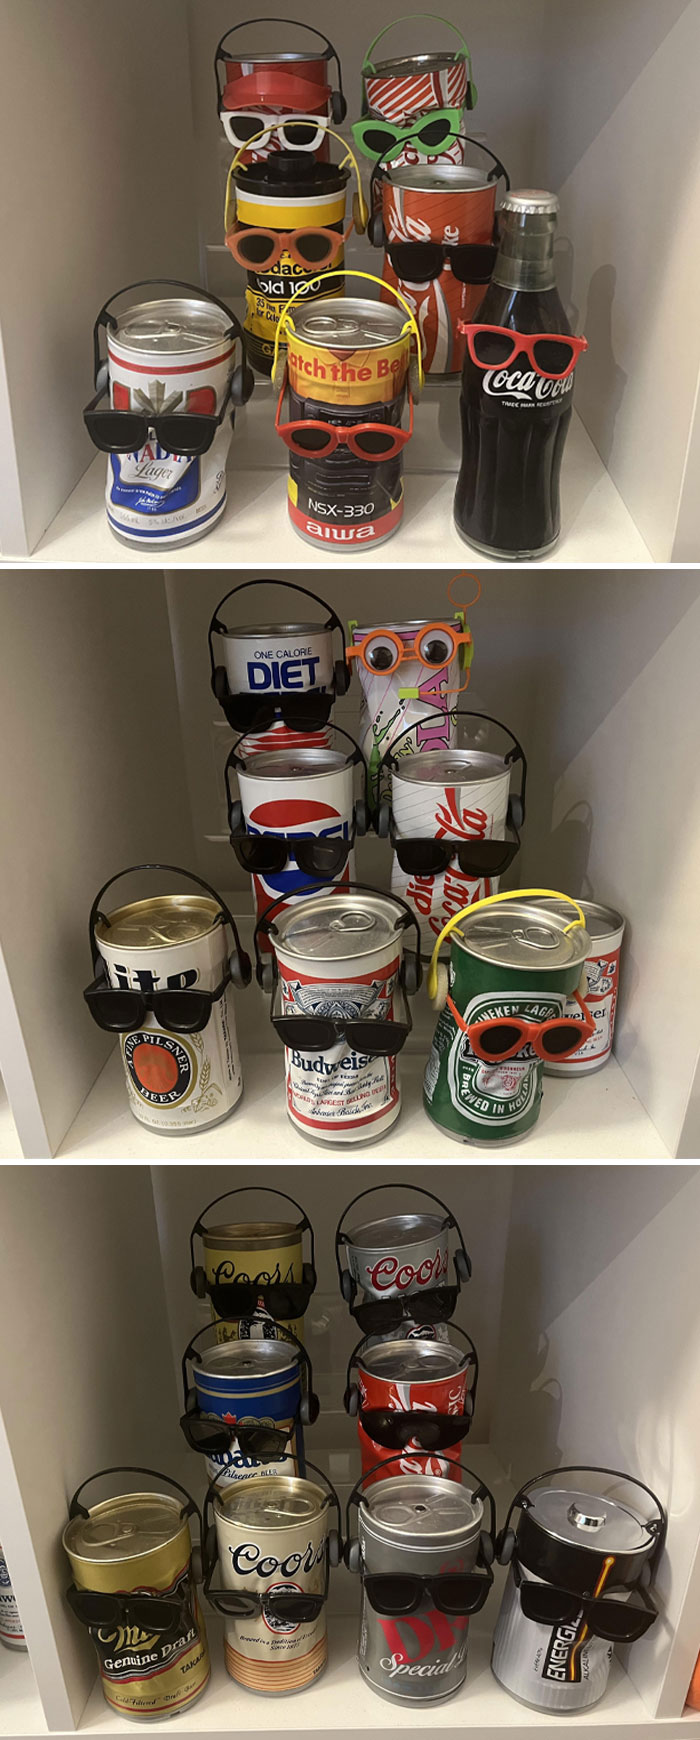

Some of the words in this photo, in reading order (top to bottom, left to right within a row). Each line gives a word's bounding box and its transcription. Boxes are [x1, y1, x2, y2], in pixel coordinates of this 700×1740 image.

[289, 280, 320, 295] 100
[331, 364, 373, 382] the
[128, 461, 173, 481] Lager
[308, 498, 375, 518] NSX-330
[306, 521, 376, 541] aiwa
[254, 650, 273, 660] ONE
[276, 647, 313, 659] CALORIE
[247, 656, 320, 690] DIET
[126, 1035, 141, 1058] FINE
[142, 1034, 189, 1075] PILSNER
[140, 1087, 181, 1103] BEER
[461, 1073, 490, 1112] BREWED
[492, 1103, 505, 1114] IN
[365, 1247, 449, 1291] Coors
[260, 1468, 278, 1477] BEER
[228, 1537, 325, 1578] Coors
[104, 1652, 158, 1670] Genuine
[161, 1627, 196, 1658] Draft
[379, 1652, 456, 1678] Special
